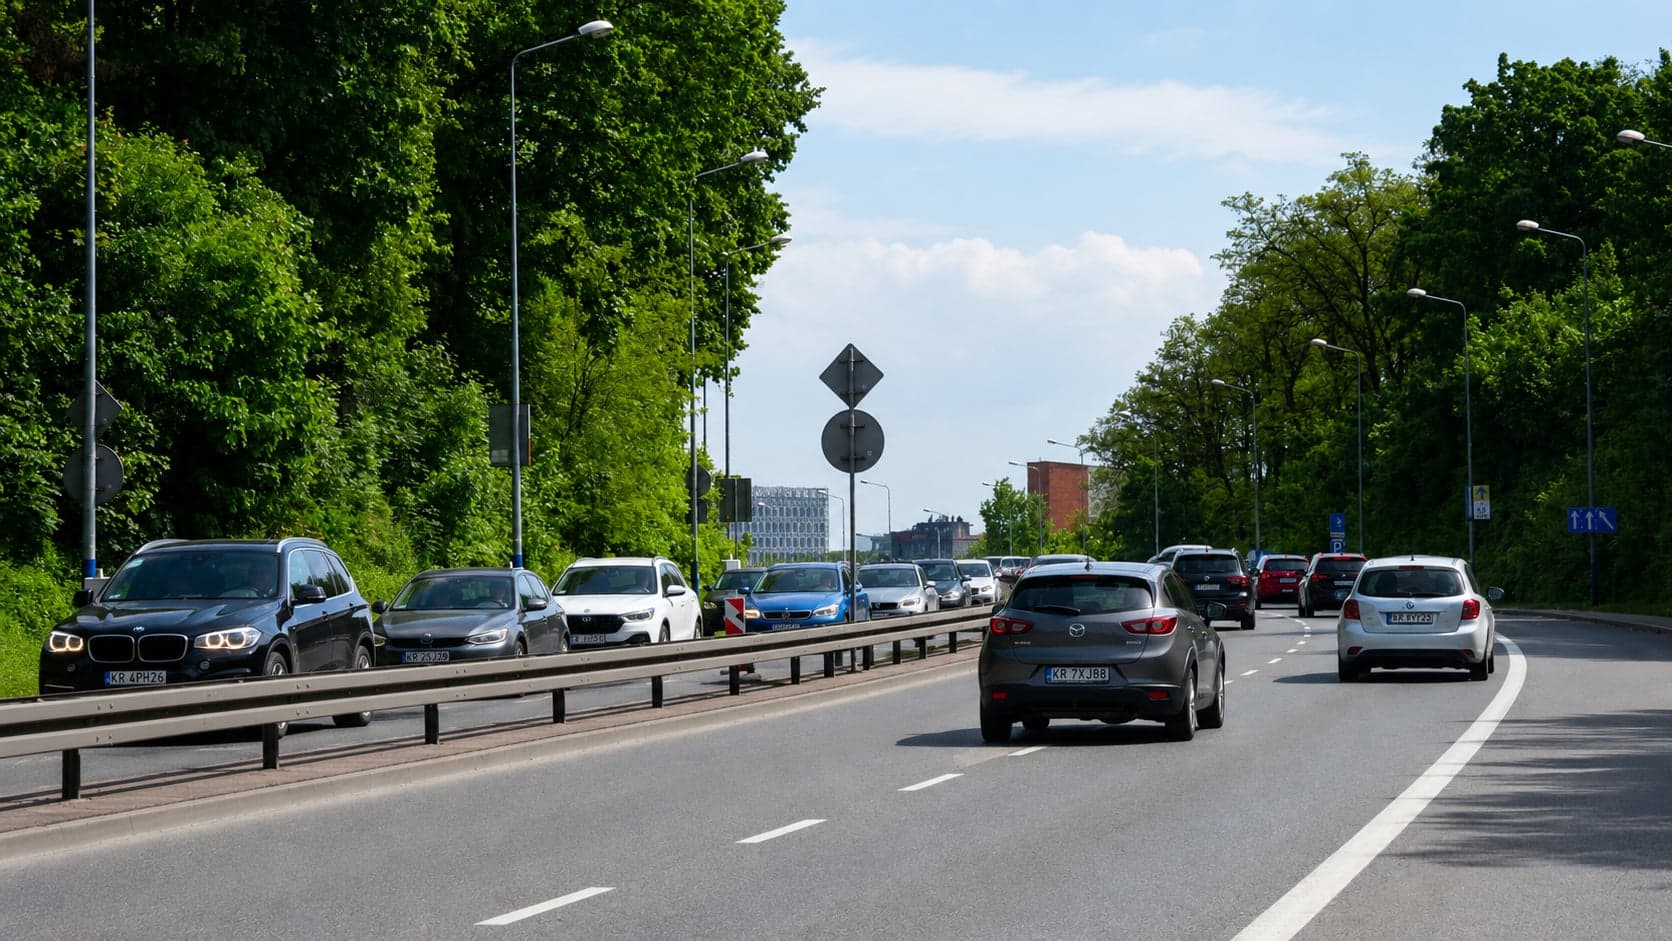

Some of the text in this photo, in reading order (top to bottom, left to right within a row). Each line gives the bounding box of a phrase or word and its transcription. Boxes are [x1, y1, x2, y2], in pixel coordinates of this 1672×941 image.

[1333, 541, 1342, 553] P
[111, 671, 164, 683] KR 4PH26
[1053, 668, 1106, 680] KR 7XJ88
